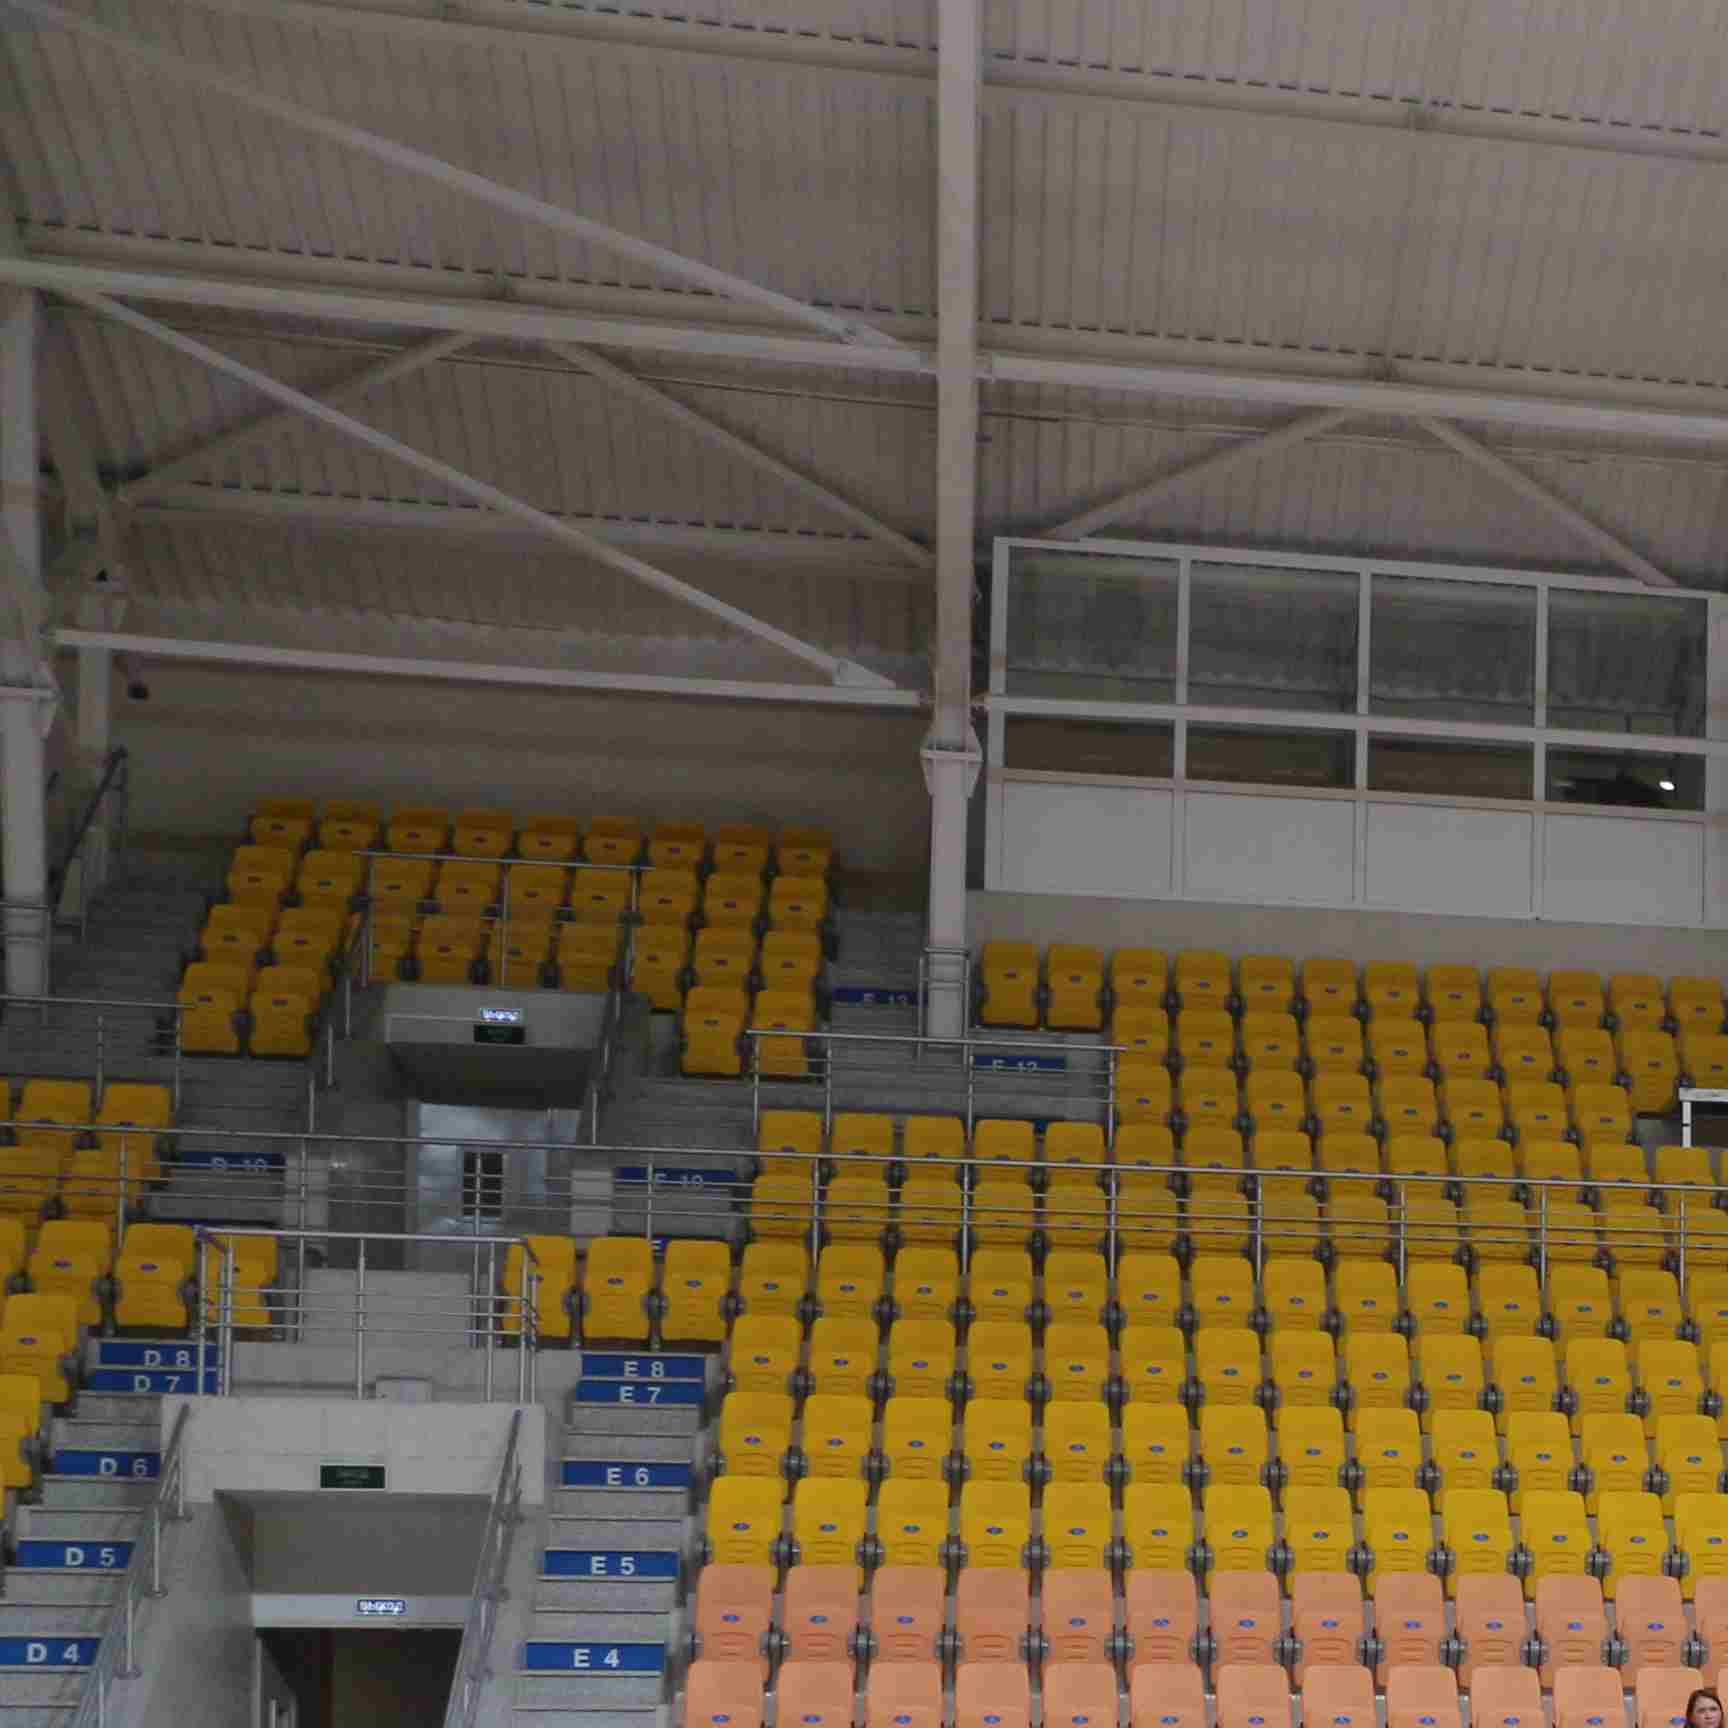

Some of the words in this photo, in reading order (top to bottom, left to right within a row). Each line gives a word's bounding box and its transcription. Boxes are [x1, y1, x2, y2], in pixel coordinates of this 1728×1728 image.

[144, 1351, 162, 1368] D
[176, 1350, 191, 1368] 8
[623, 1360, 639, 1378] E
[650, 1361, 665, 1378] 8
[133, 1374, 150, 1393] D
[165, 1375, 181, 1393] 7
[619, 1385, 635, 1403] E
[647, 1386, 662, 1403] 7
[99, 1457, 118, 1475] D
[132, 1458, 149, 1477] 6
[606, 1467, 622, 1486] E
[634, 1468, 650, 1486] 6
[65, 1547, 85, 1567] D
[100, 1548, 116, 1567] 5
[590, 1556, 607, 1575] E
[620, 1557, 636, 1575] 5
[26, 1642, 48, 1663] D
[63, 1643, 80, 1663] 4
[573, 1649, 591, 1668] E
[603, 1649, 620, 1668] 4
